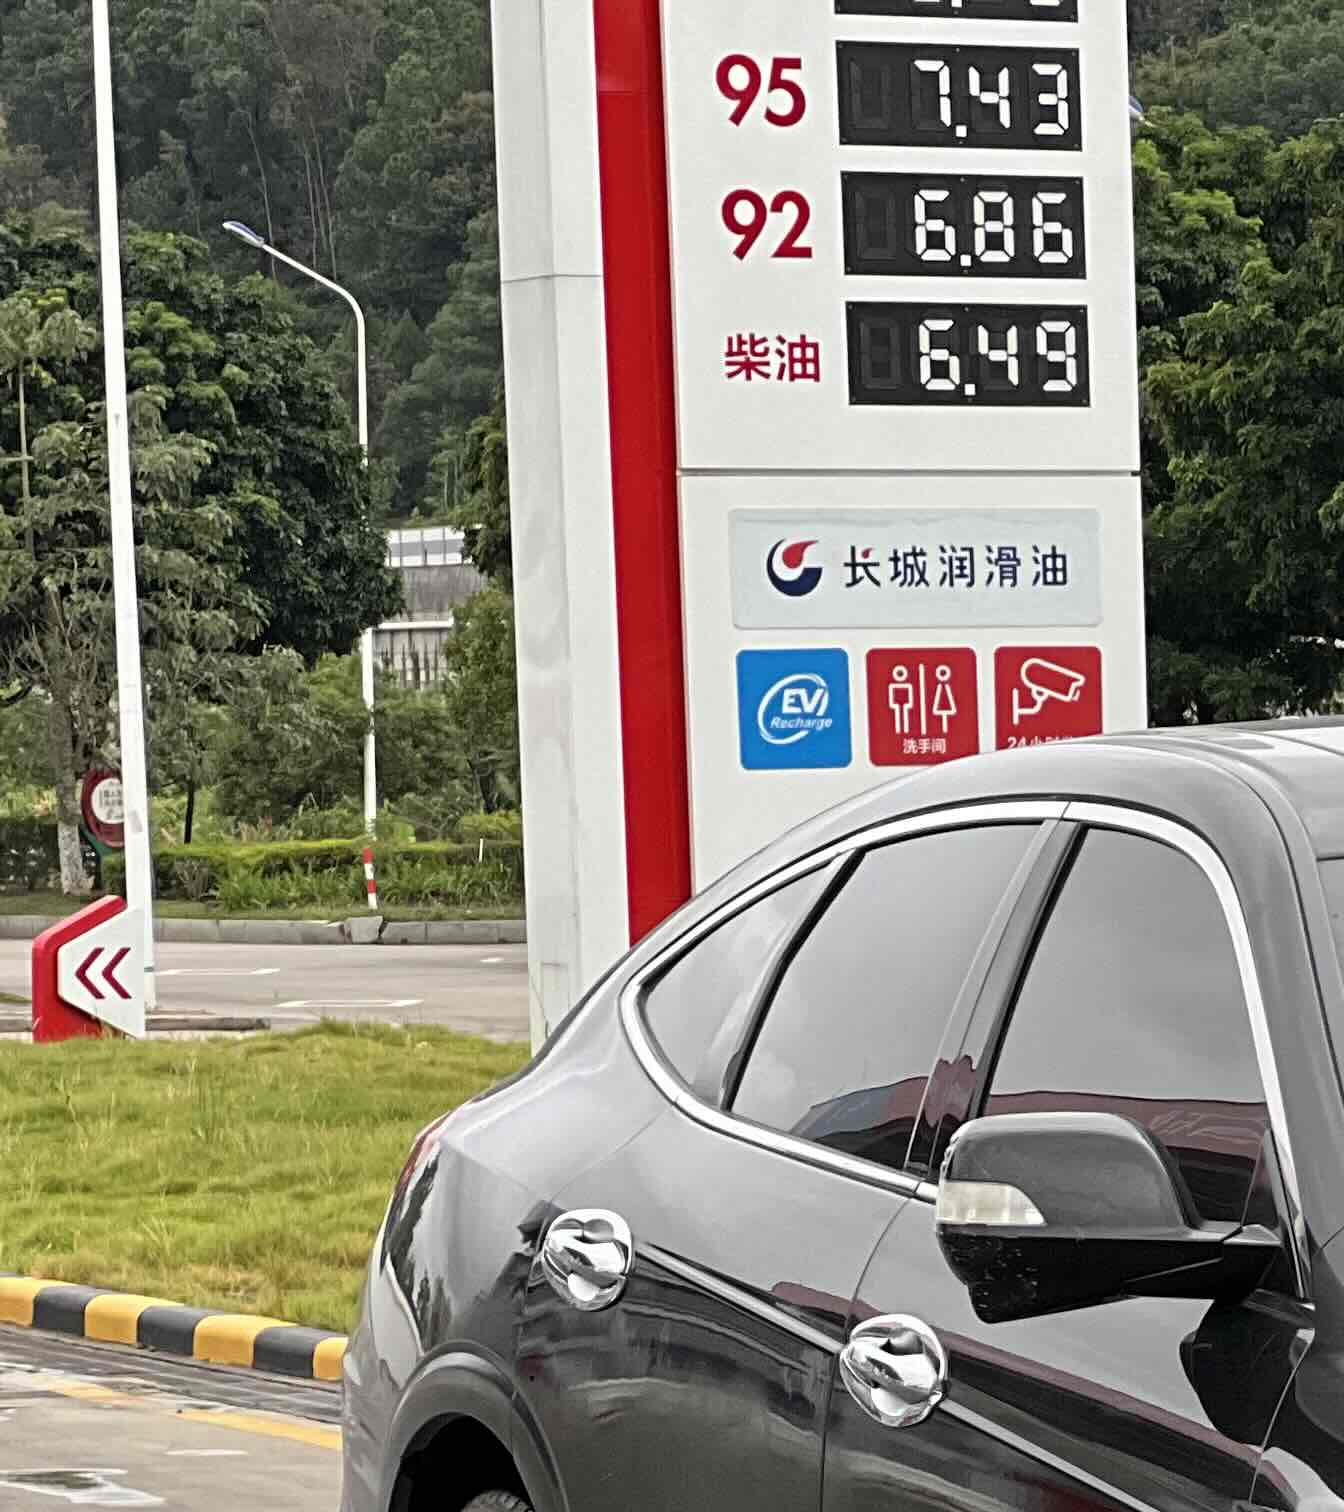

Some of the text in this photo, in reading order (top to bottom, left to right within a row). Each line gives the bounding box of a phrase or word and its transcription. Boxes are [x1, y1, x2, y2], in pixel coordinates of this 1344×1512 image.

[715, 54, 1070, 138] 95 7.43
[721, 188, 1074, 267] 92 6.86
[724, 319, 1077, 396] 柴油 6.49
[843, 545, 1069, 588] 长城润滑油
[770, 716, 832, 731] Recharge
[903, 738, 946, 754] 洗手间
